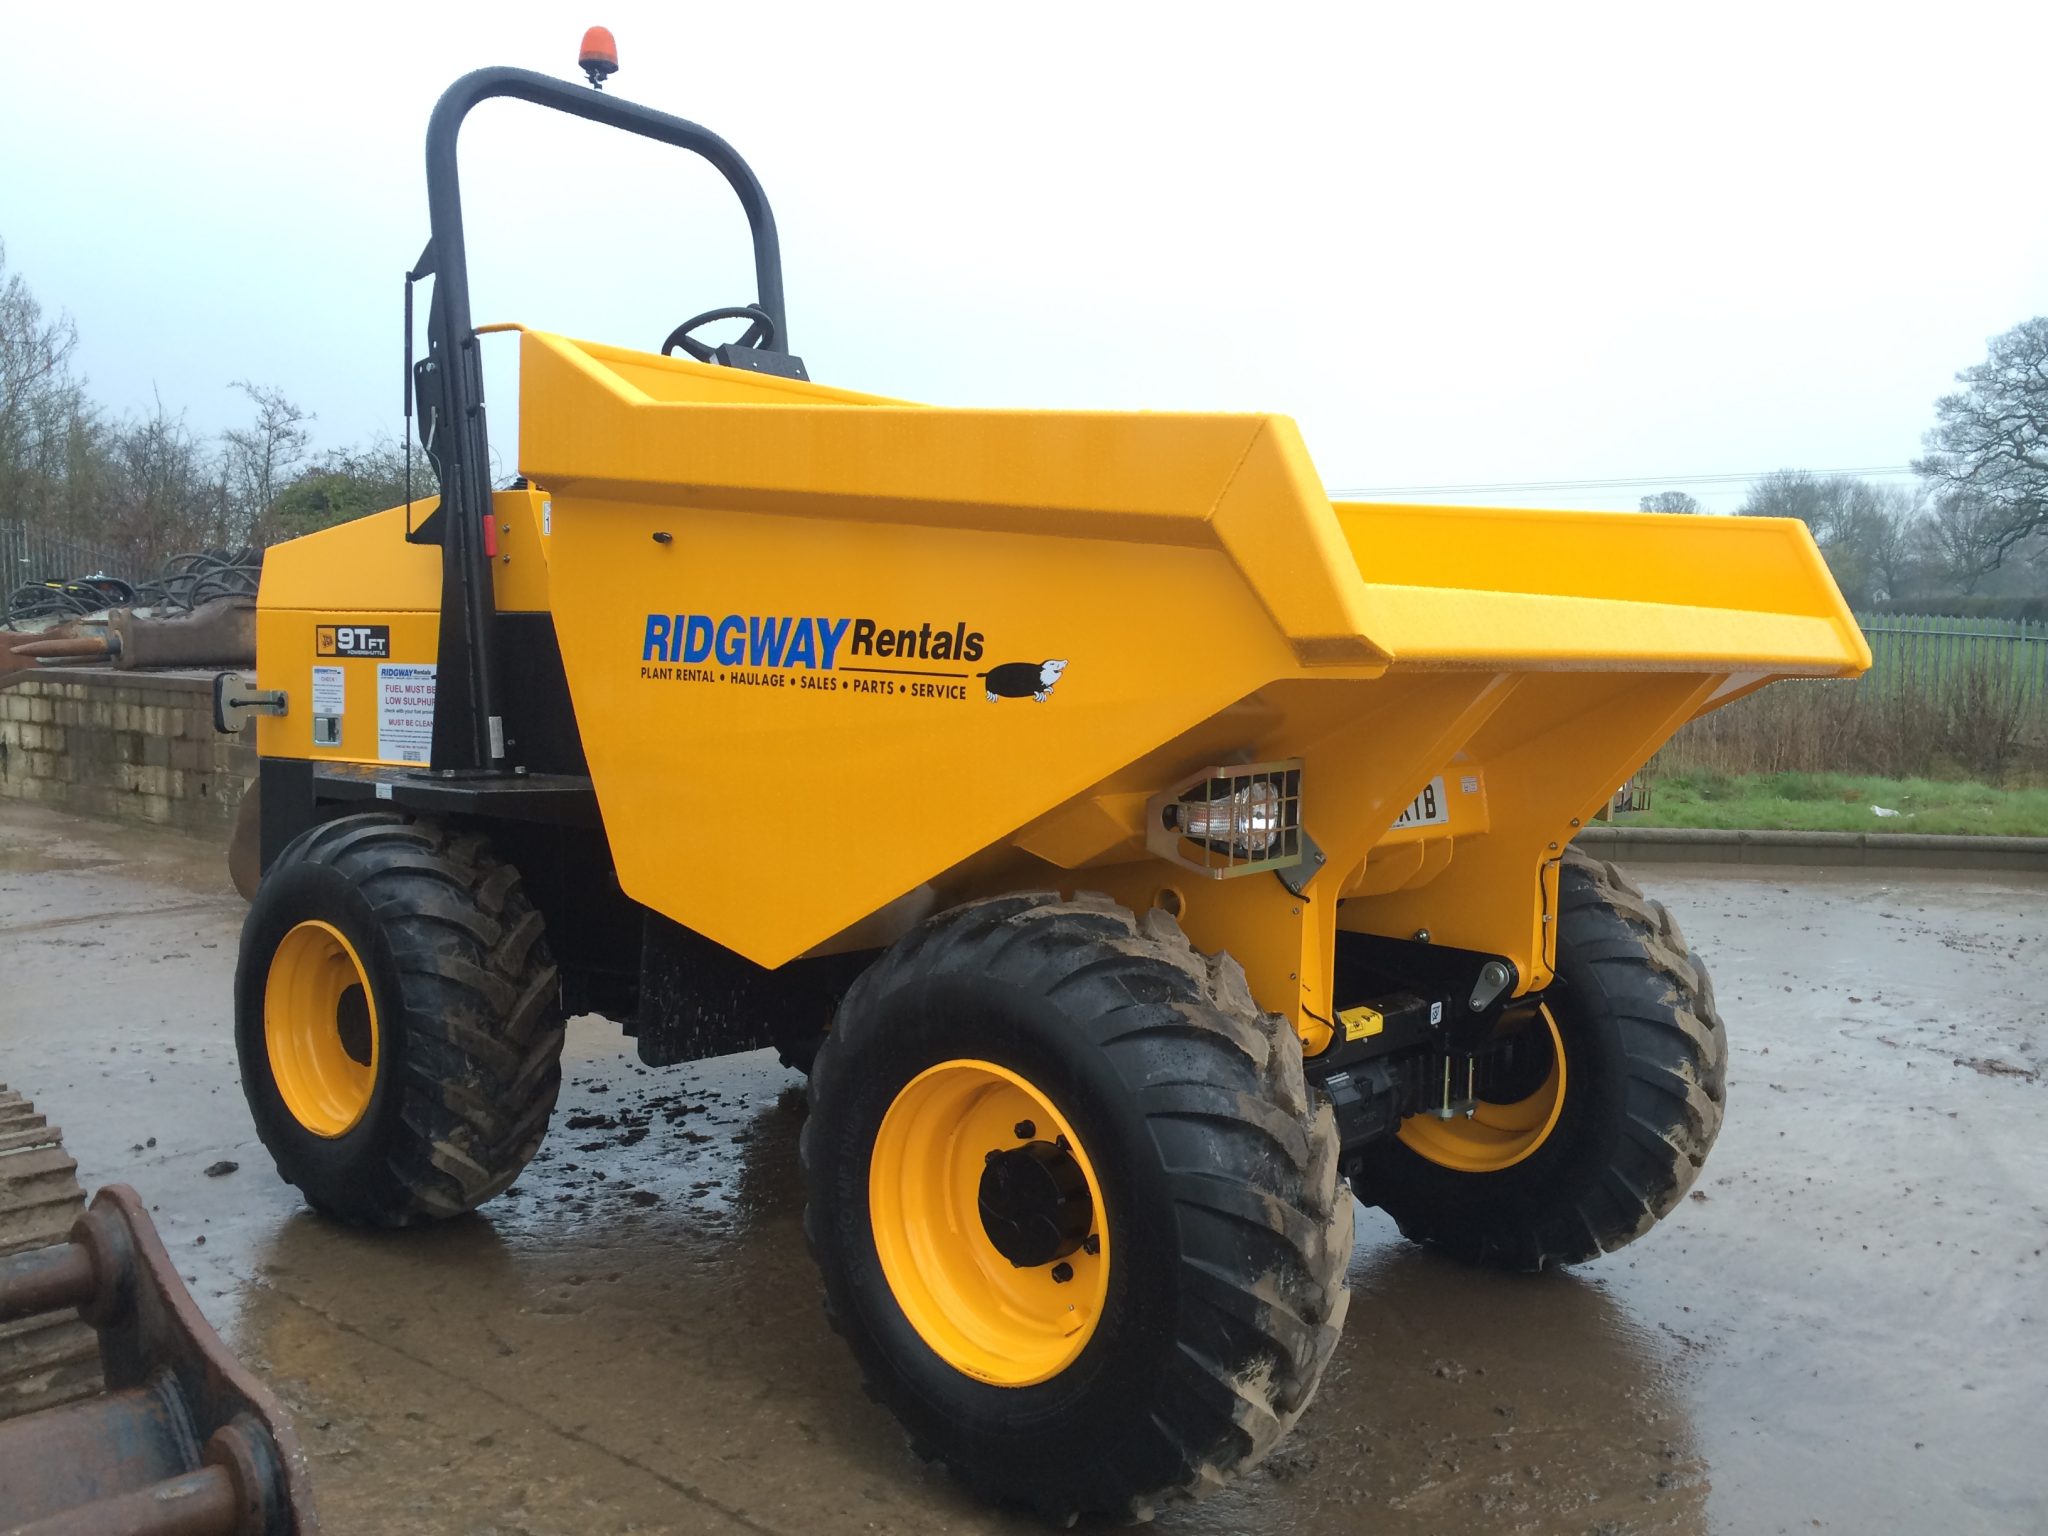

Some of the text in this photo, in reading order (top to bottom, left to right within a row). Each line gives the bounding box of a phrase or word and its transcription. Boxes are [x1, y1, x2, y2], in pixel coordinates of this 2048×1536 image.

[642, 614, 985, 670] RIDGWAY Rentals
[381, 668, 413, 677] RIDGWAY
[641, 667, 966, 700] PLANT RENTAL HAULAGE SALES PARTS SERVICE
[385, 684, 436, 694] FUEL MUST BE
[385, 697, 401, 705] LOW
[405, 719, 414, 727] BE
